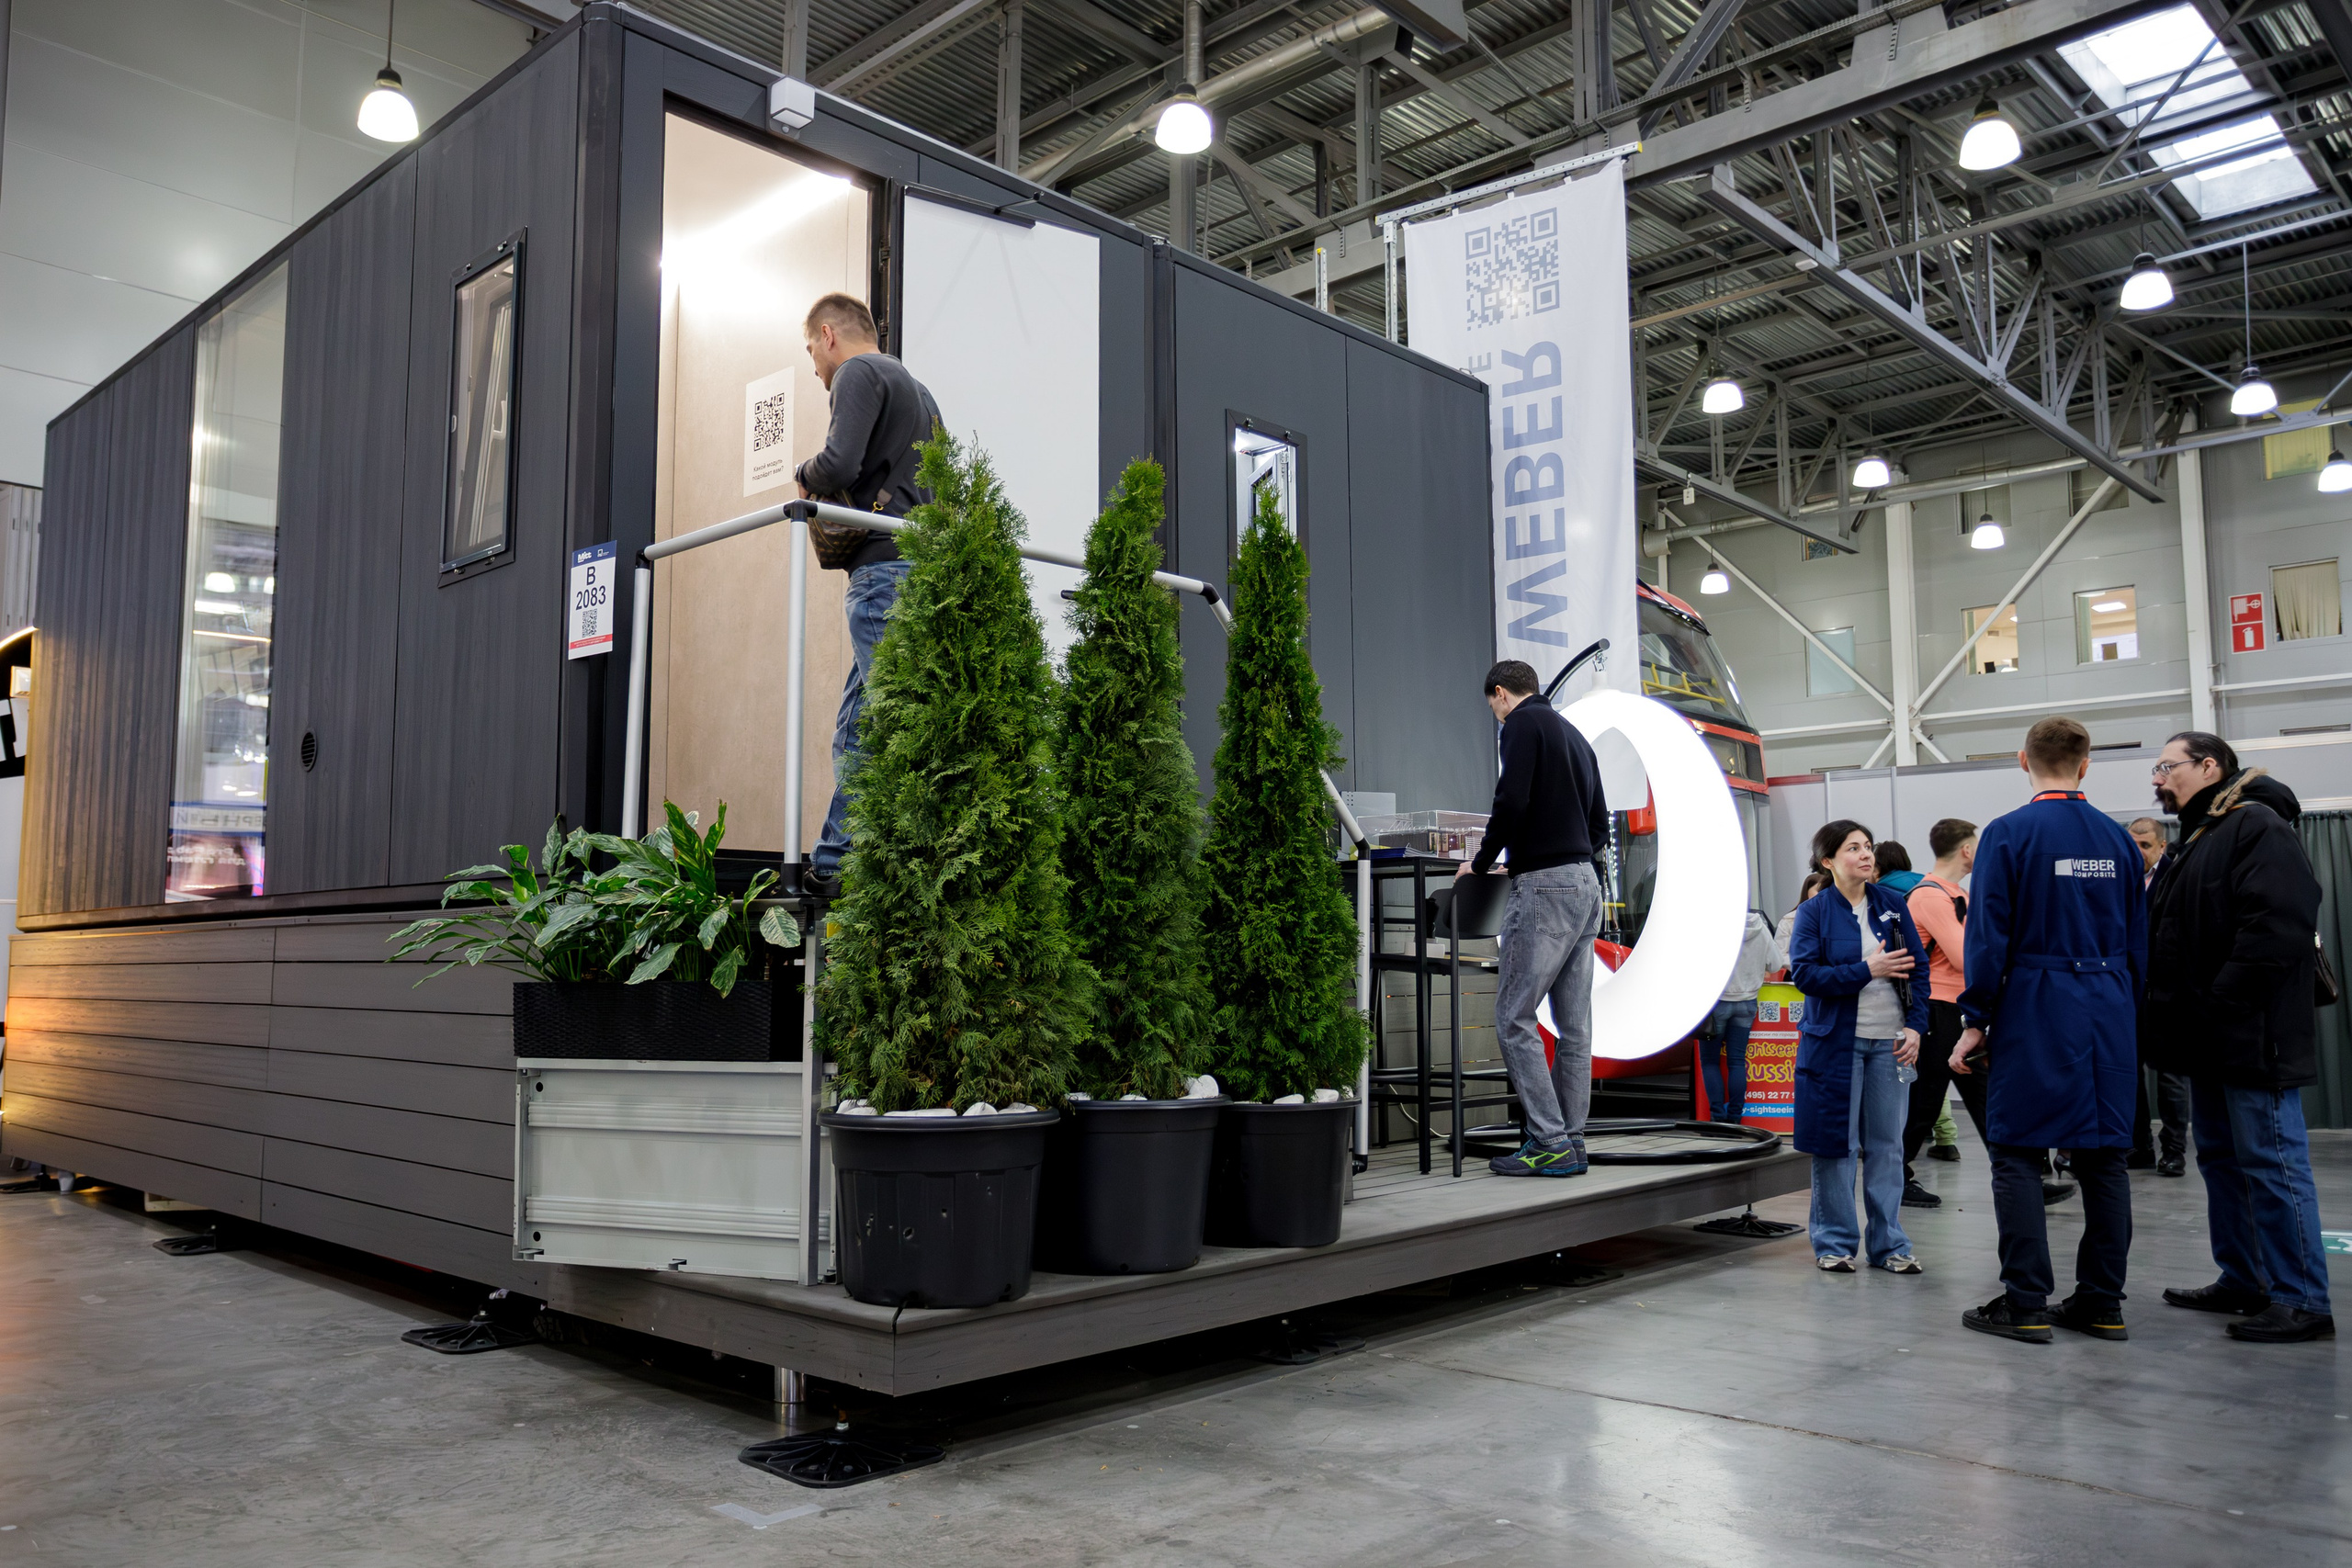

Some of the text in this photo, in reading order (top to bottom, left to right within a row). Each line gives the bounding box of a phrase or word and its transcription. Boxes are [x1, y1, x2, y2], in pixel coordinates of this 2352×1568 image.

[752, 465, 784, 480] подойдет вам?
[753, 458, 783, 472] Какой модуль
[586, 566, 596, 586] B
[575, 585, 606, 611] 2083
[2071, 858, 2115, 872] WEBER
[1746, 1042, 1798, 1058] ghtseei
[1746, 1059, 1795, 1082] Russi
[1744, 1090, 1766, 1100] (495)
[1768, 1090, 1779, 1100] 22
[1780, 1090, 1791, 1100] 77
[1742, 1105, 1794, 1114] y-sightseein
